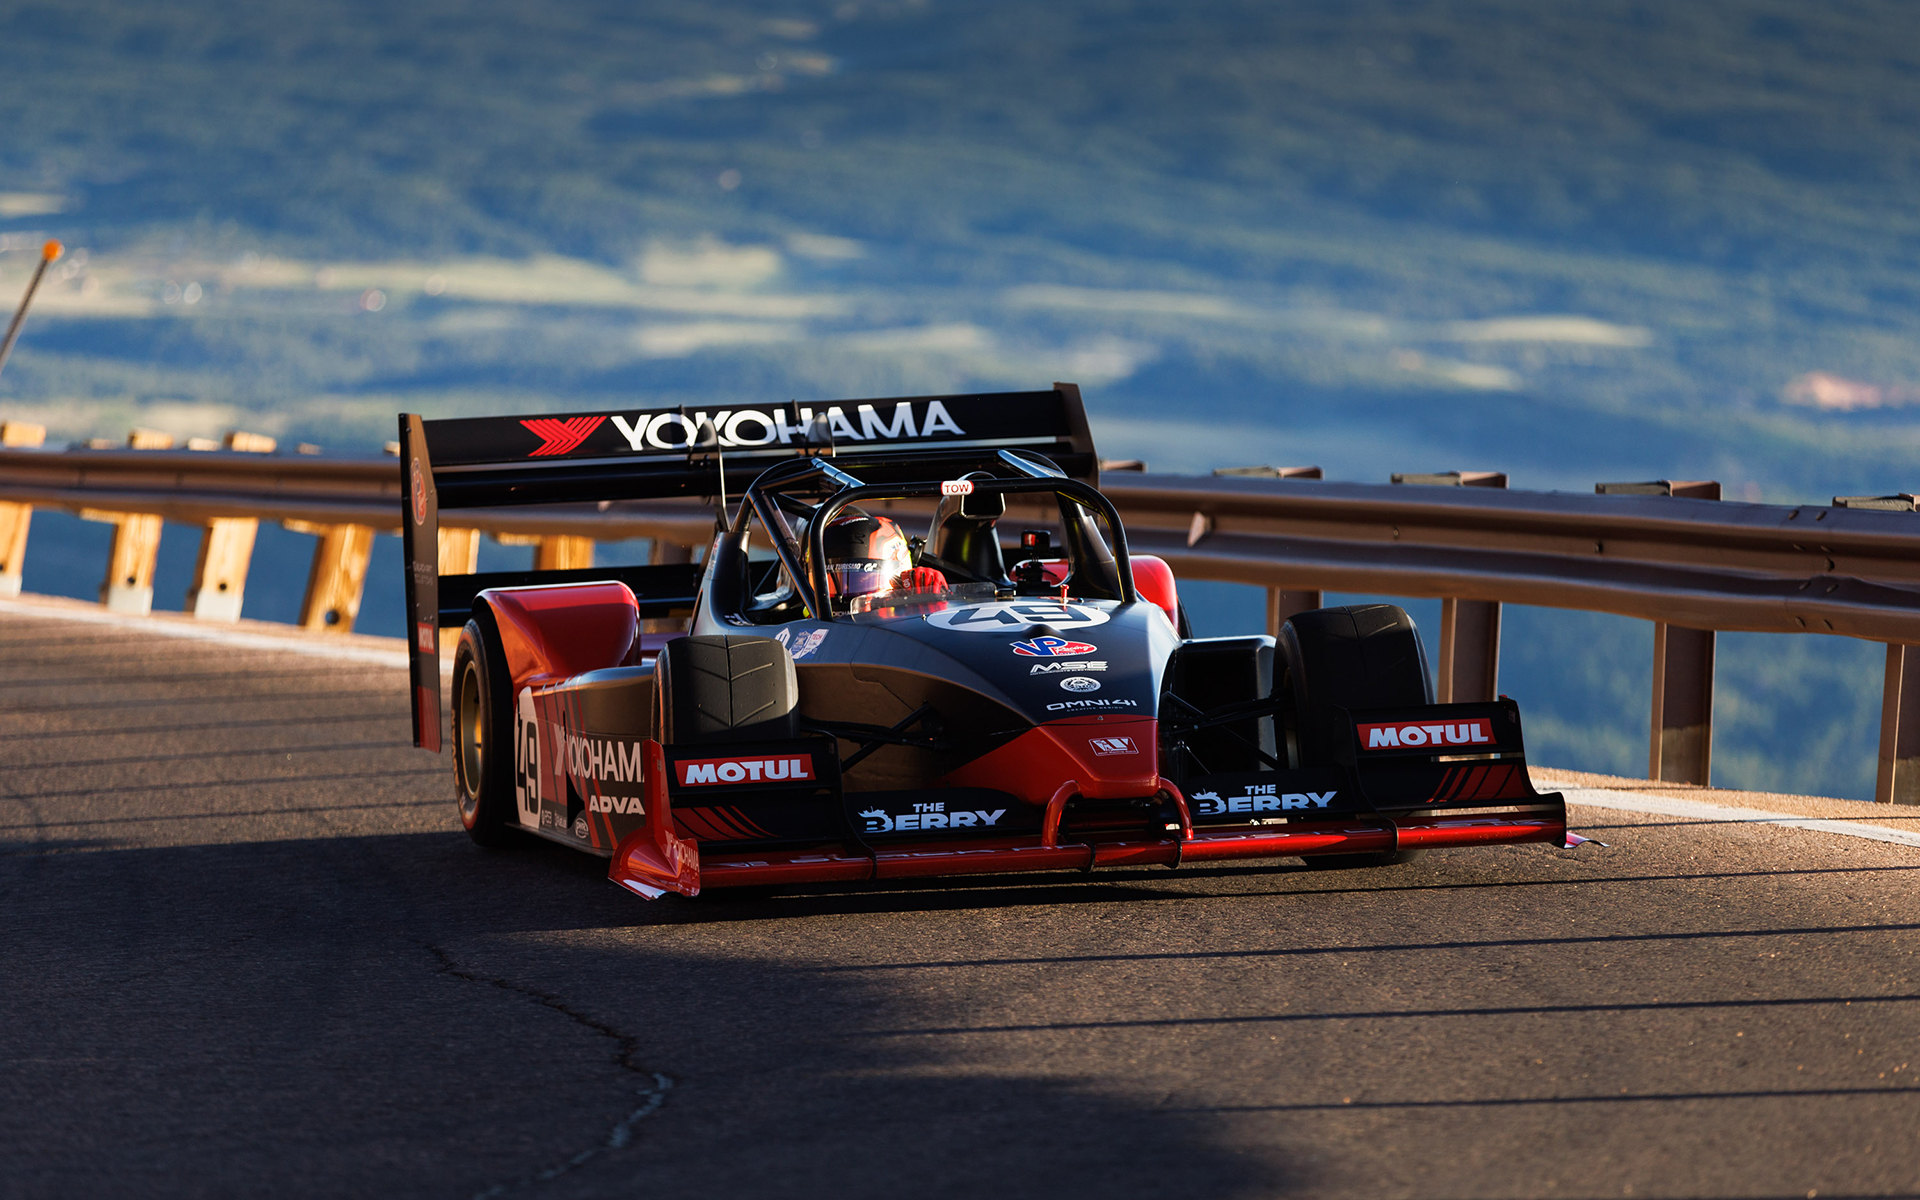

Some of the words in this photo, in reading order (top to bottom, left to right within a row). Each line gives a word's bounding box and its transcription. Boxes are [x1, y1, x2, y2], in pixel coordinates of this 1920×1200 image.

[611, 400, 966, 451] YOKOHAMA
[944, 484, 969, 493] TOW
[948, 605, 1092, 625] 49
[1010, 635, 1067, 656] VP
[1030, 661, 1108, 673] MSE
[1368, 723, 1489, 747] MOTUL
[567, 735, 645, 783] YOKOHAM
[685, 759, 808, 784] MOTUL
[1244, 784, 1276, 795] THE
[913, 802, 945, 813] THE
[1191, 788, 1337, 815] BERRY
[858, 806, 1006, 833] BERRY
